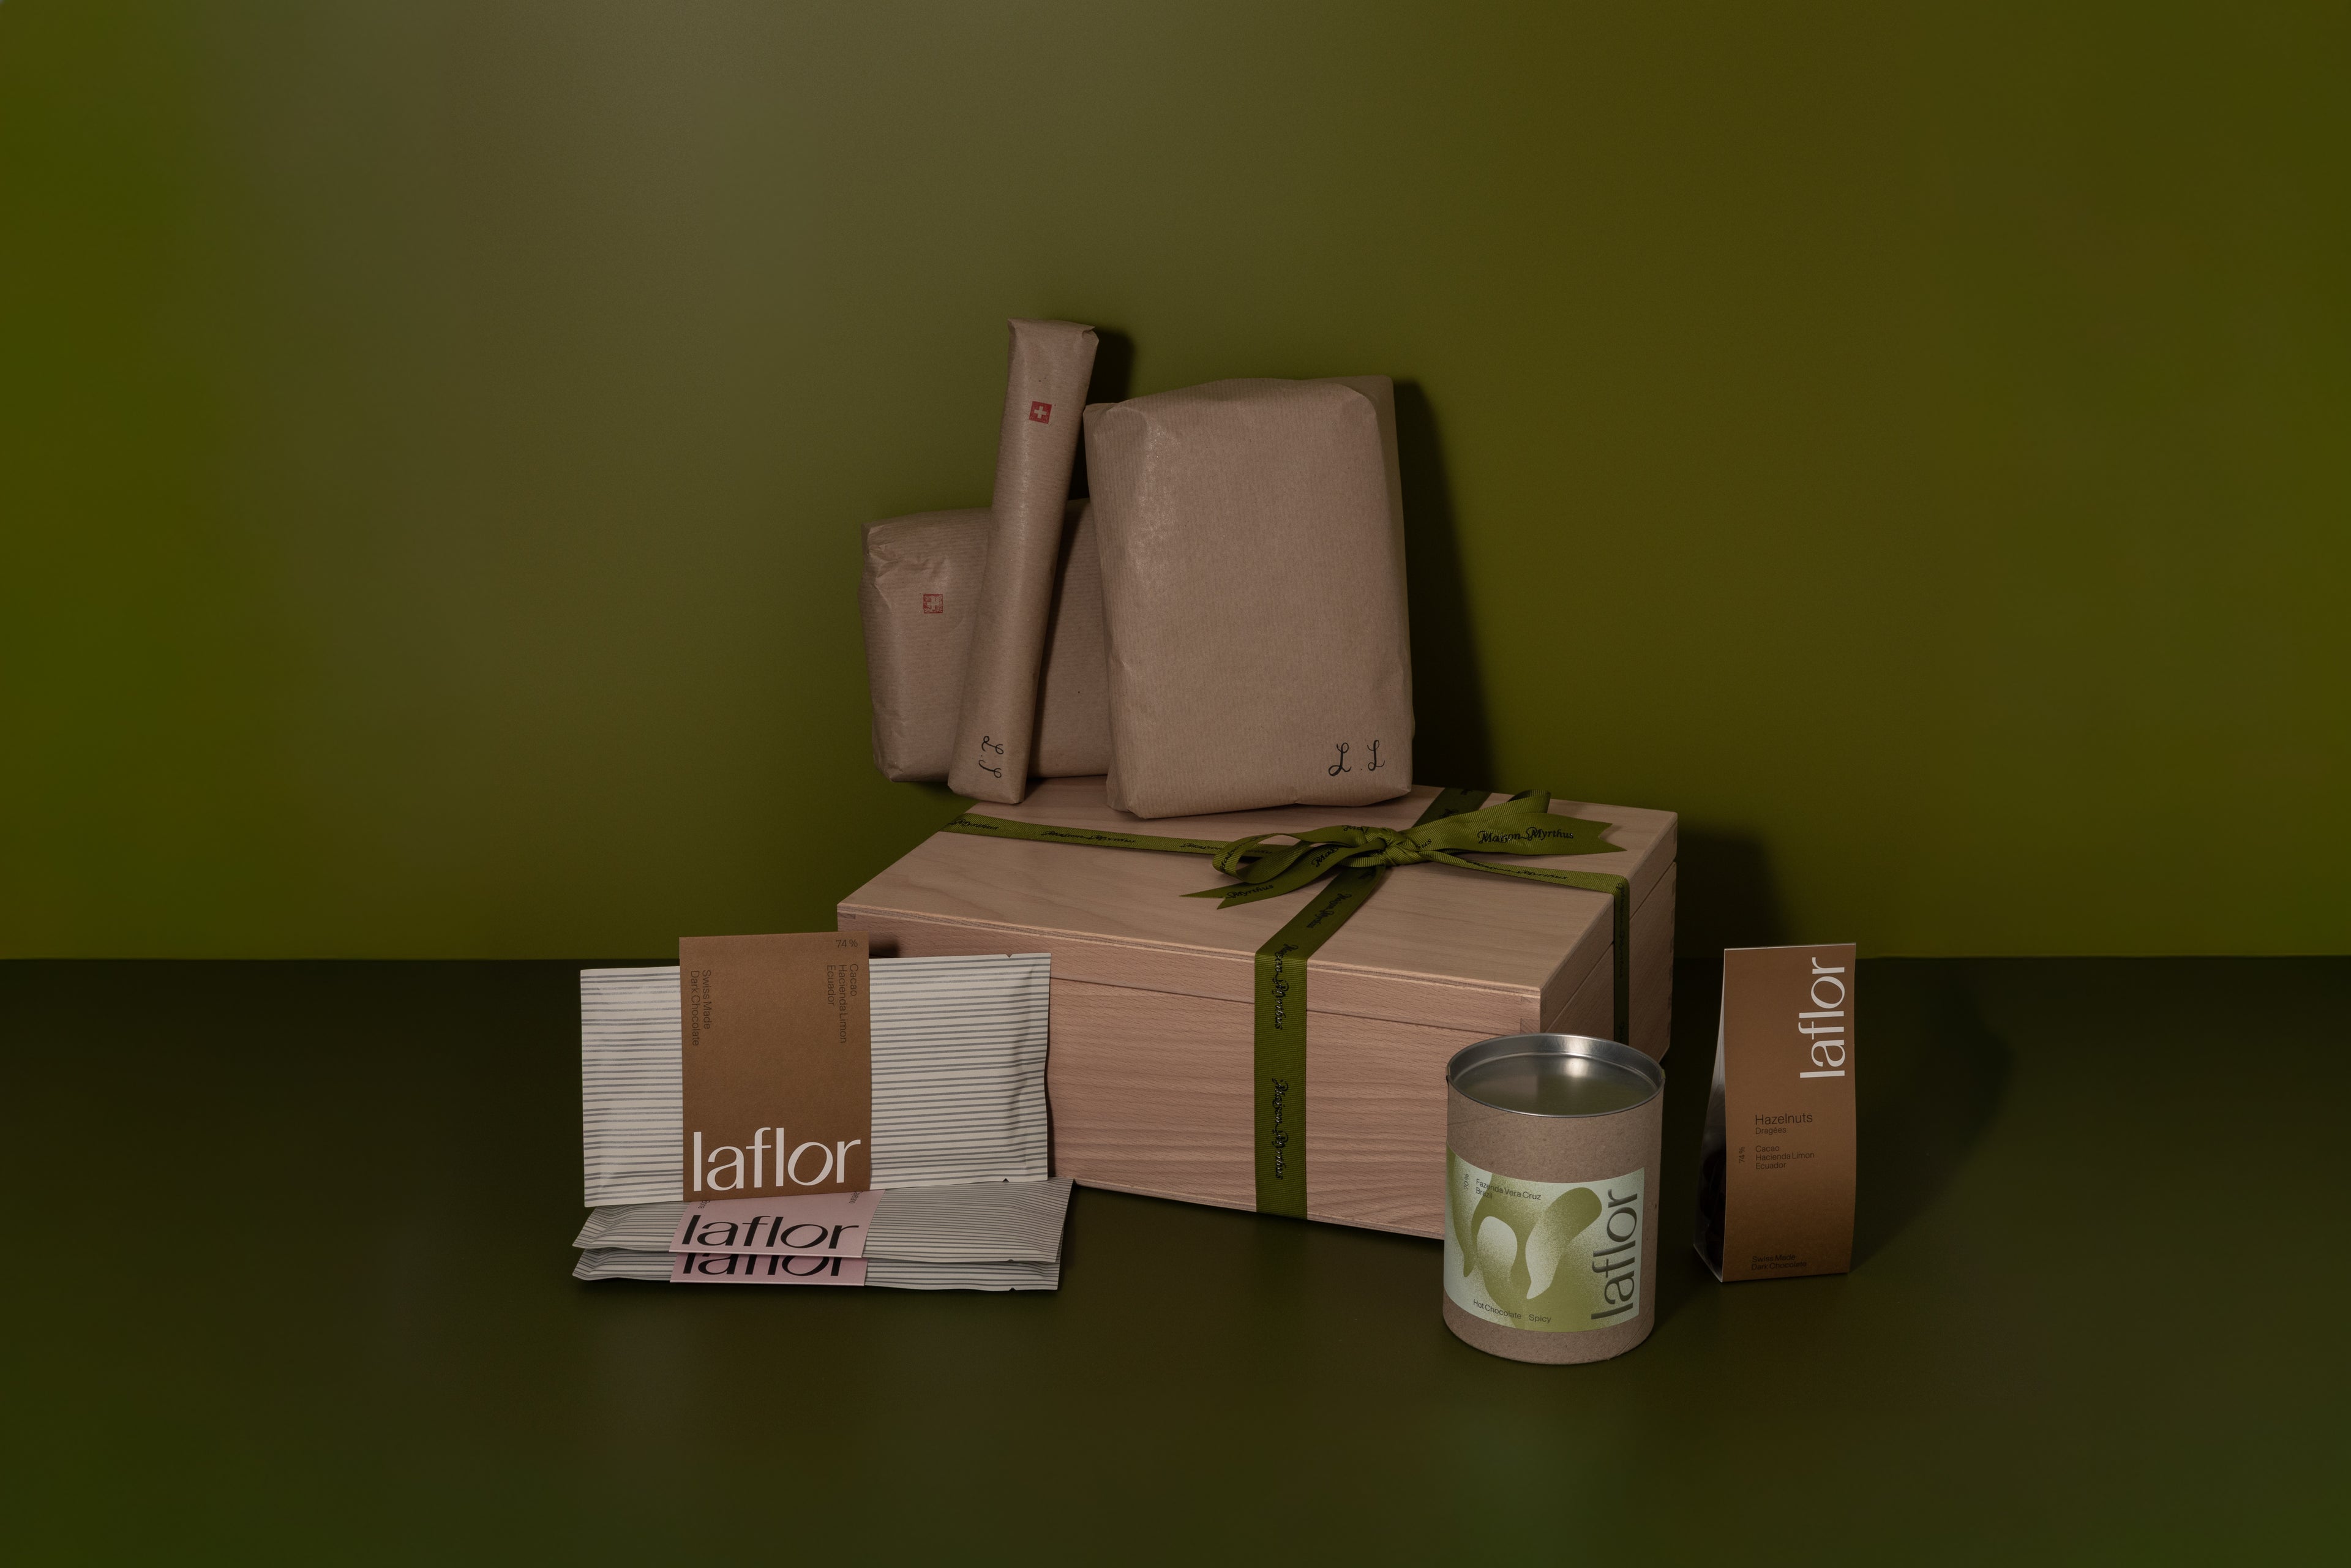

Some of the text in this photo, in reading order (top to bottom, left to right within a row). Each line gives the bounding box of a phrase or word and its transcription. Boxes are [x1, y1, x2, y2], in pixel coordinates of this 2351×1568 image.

[1477, 827, 1574, 844] Maison Myrthus
[1226, 884, 1274, 899] Myrthus
[827, 965, 836, 1006] Ecuador
[850, 964, 858, 996] Cacao
[691, 970, 700, 1046] Dark Chocolate
[702, 969, 711, 1030] Swiss Made
[838, 964, 847, 1043] Hacienda Limon
[1798, 957, 1846, 1079] laflor
[1272, 1078, 1289, 1180] Maison Myrthus
[1755, 1113, 1813, 1125] Hazelnuts
[1755, 1127, 1787, 1136] Dragées
[693, 1127, 861, 1191] laflor
[1475, 1187, 1493, 1199] Brazil
[1476, 1179, 1542, 1200] Fazenda Vera Cruz
[681, 1215, 860, 1249] laflor
[1591, 1188, 1638, 1320] laflor
[1769, 1261, 1807, 1269] Chocolate
[1473, 1299, 1551, 1324] Hot Chocolate Spicy
